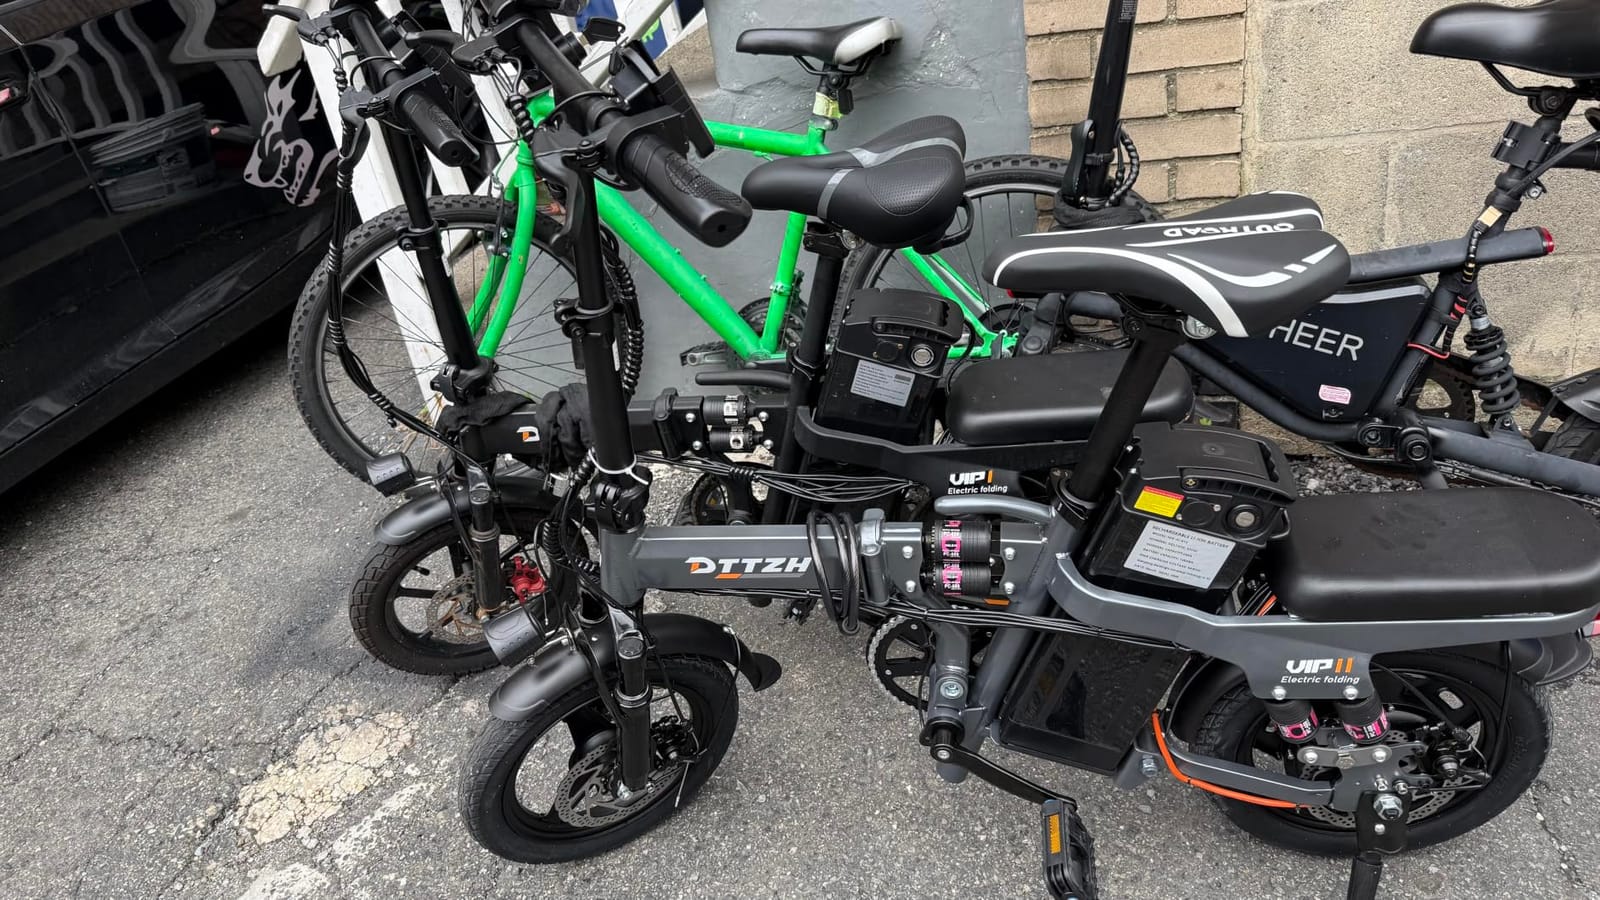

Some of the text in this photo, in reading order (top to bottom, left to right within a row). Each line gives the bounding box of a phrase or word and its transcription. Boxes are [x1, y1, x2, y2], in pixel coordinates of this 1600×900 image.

[948, 485, 1008, 495] Electric folding
[685, 556, 812, 574] DTTZH
[1281, 675, 1360, 685] Electric folding
